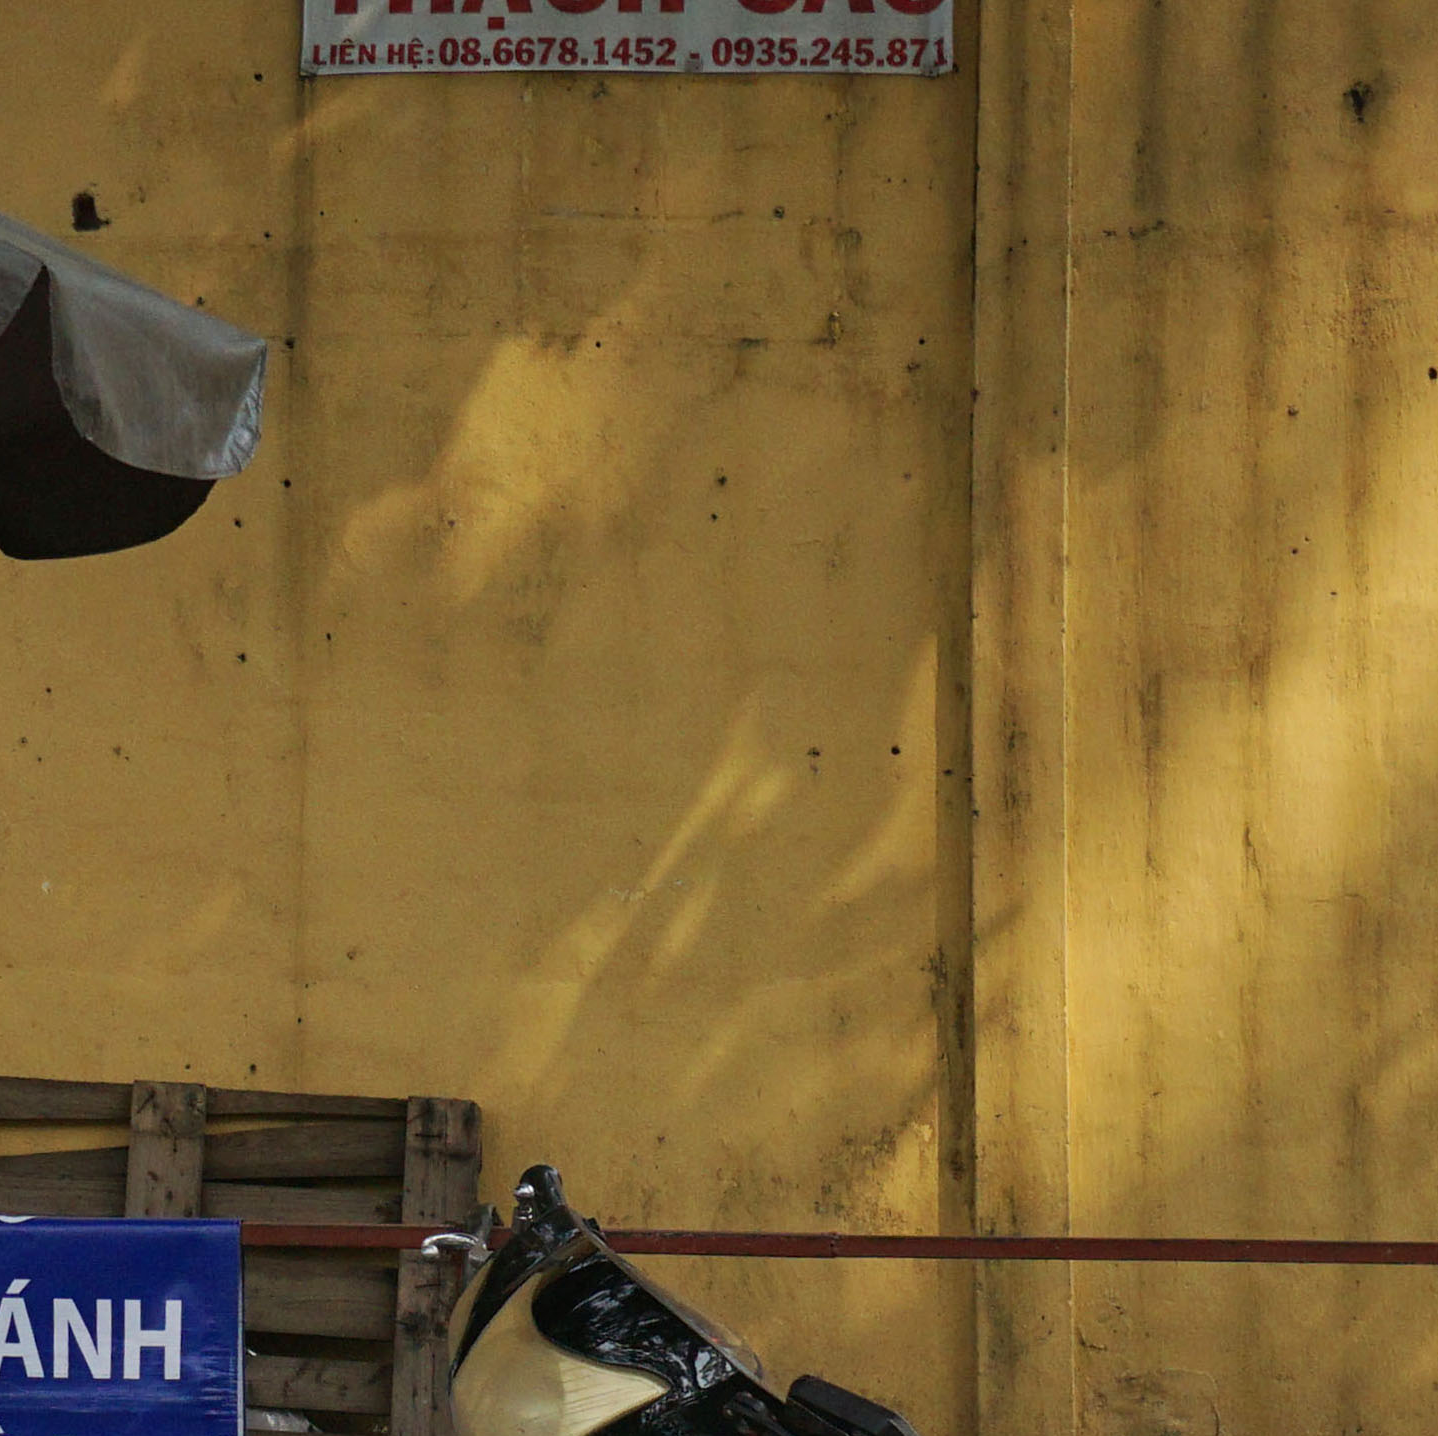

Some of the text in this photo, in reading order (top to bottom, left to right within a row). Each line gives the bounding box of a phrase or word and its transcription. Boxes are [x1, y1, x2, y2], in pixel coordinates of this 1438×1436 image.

[312, 38, 376, 66] LIÊN
[439, 36, 677, 67] 08.6678.1452
[711, 36, 948, 68] 0935.245.871
